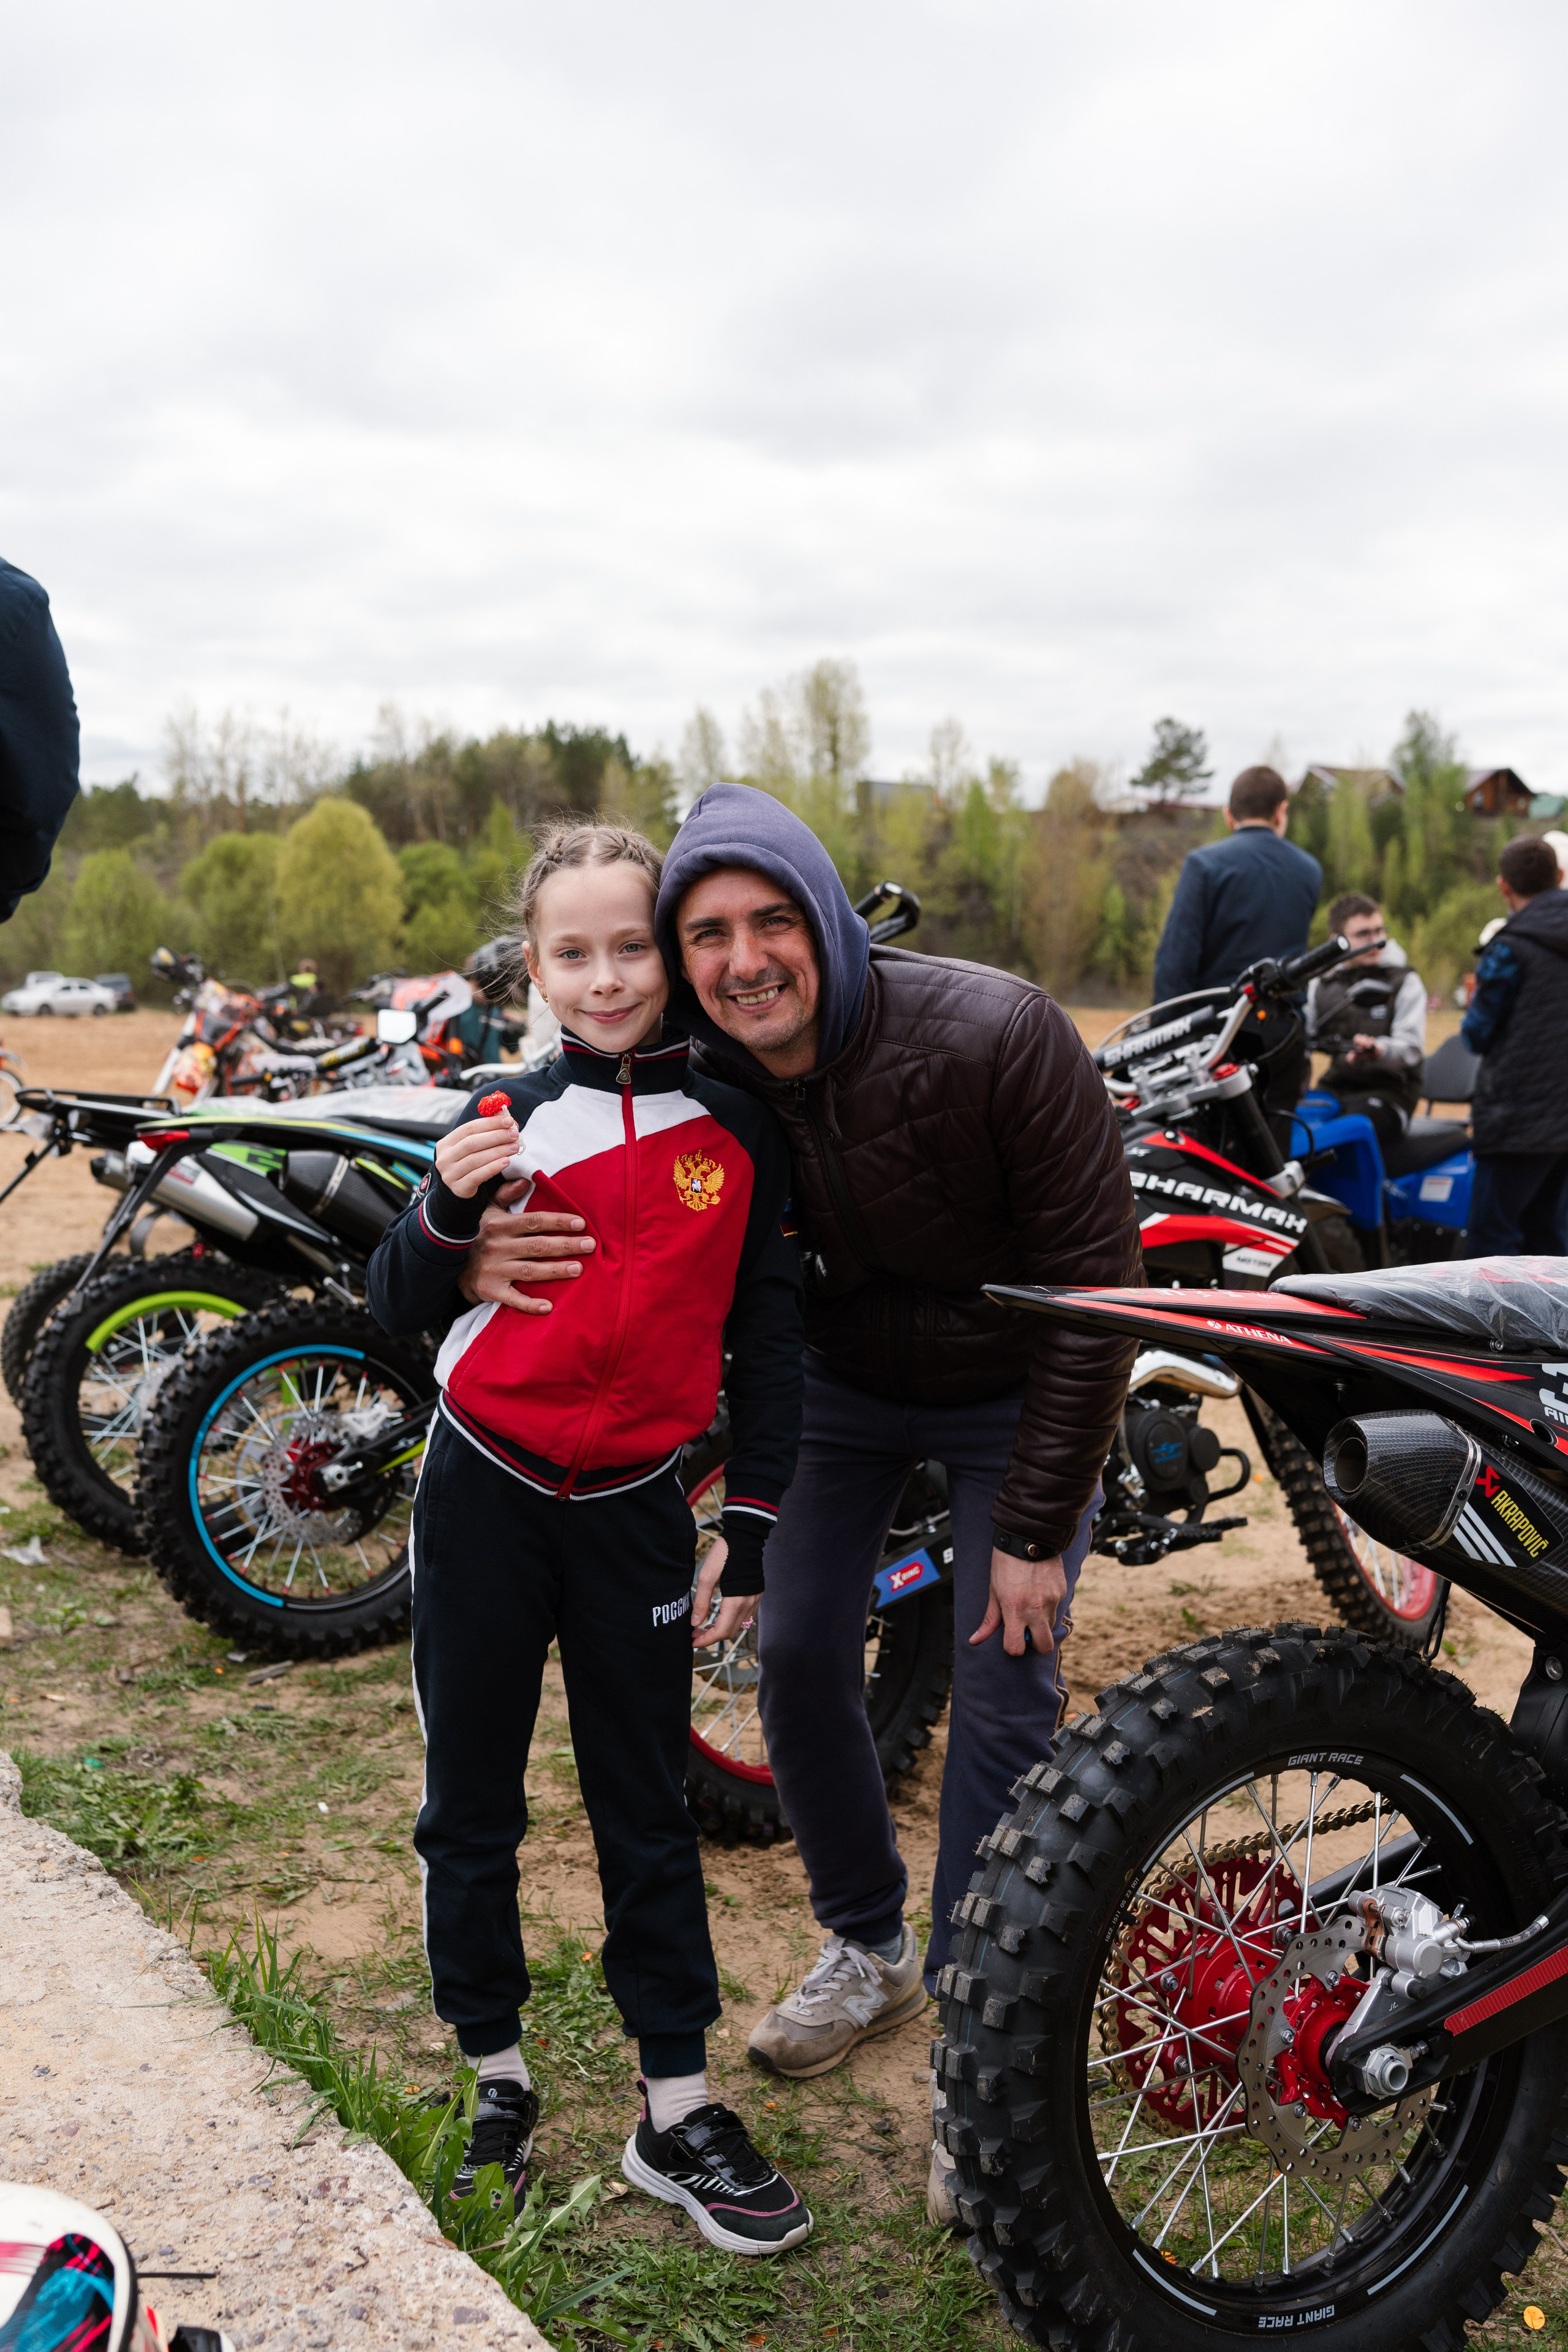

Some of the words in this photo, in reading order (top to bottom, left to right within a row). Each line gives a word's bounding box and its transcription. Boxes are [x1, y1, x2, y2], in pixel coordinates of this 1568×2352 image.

[1129, 1170, 1308, 1234] SHARMAX
[1226, 1324, 1294, 1344] ATHENA
[1287, 1752, 1327, 1766] GIANT
[1328, 1752, 1364, 1765] RACE
[1131, 1877, 1140, 1889] DOT
[1258, 2315, 1294, 2328] RACE
[1296, 2304, 1335, 2326] GIANT
